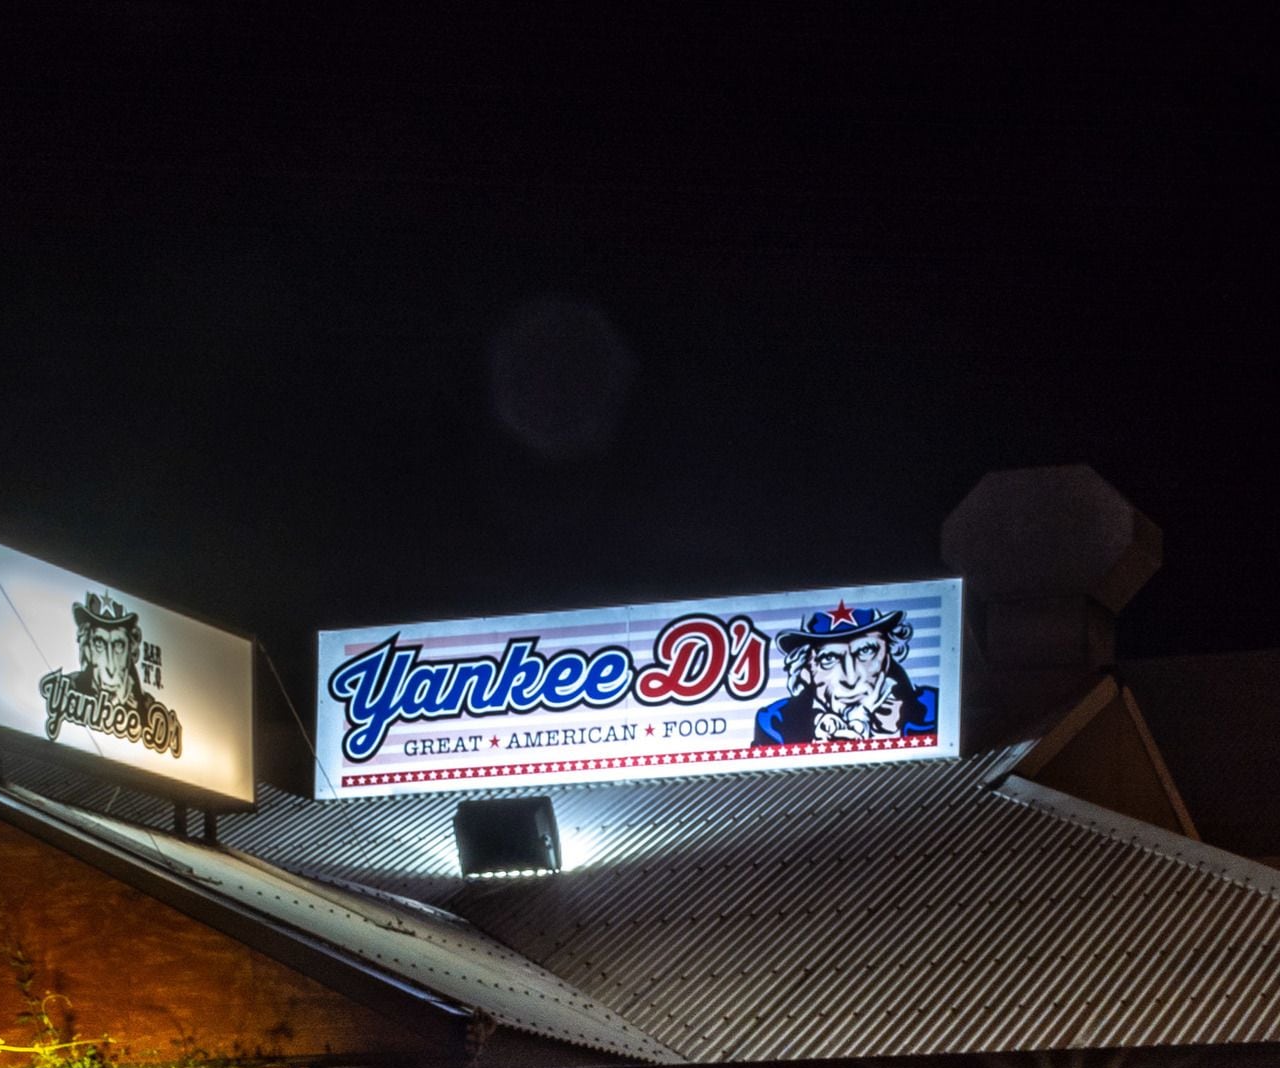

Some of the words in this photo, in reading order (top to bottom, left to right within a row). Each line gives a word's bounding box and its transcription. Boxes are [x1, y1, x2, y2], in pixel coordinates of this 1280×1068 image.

[39, 667, 142, 743] Yankee
[141, 701, 183, 759] D's
[328, 630, 634, 762] Yankee
[631, 612, 774, 706] D's
[403, 735, 482, 757] GREAT
[505, 723, 637, 750] AMERICAN
[662, 716, 728, 738] FOOD
